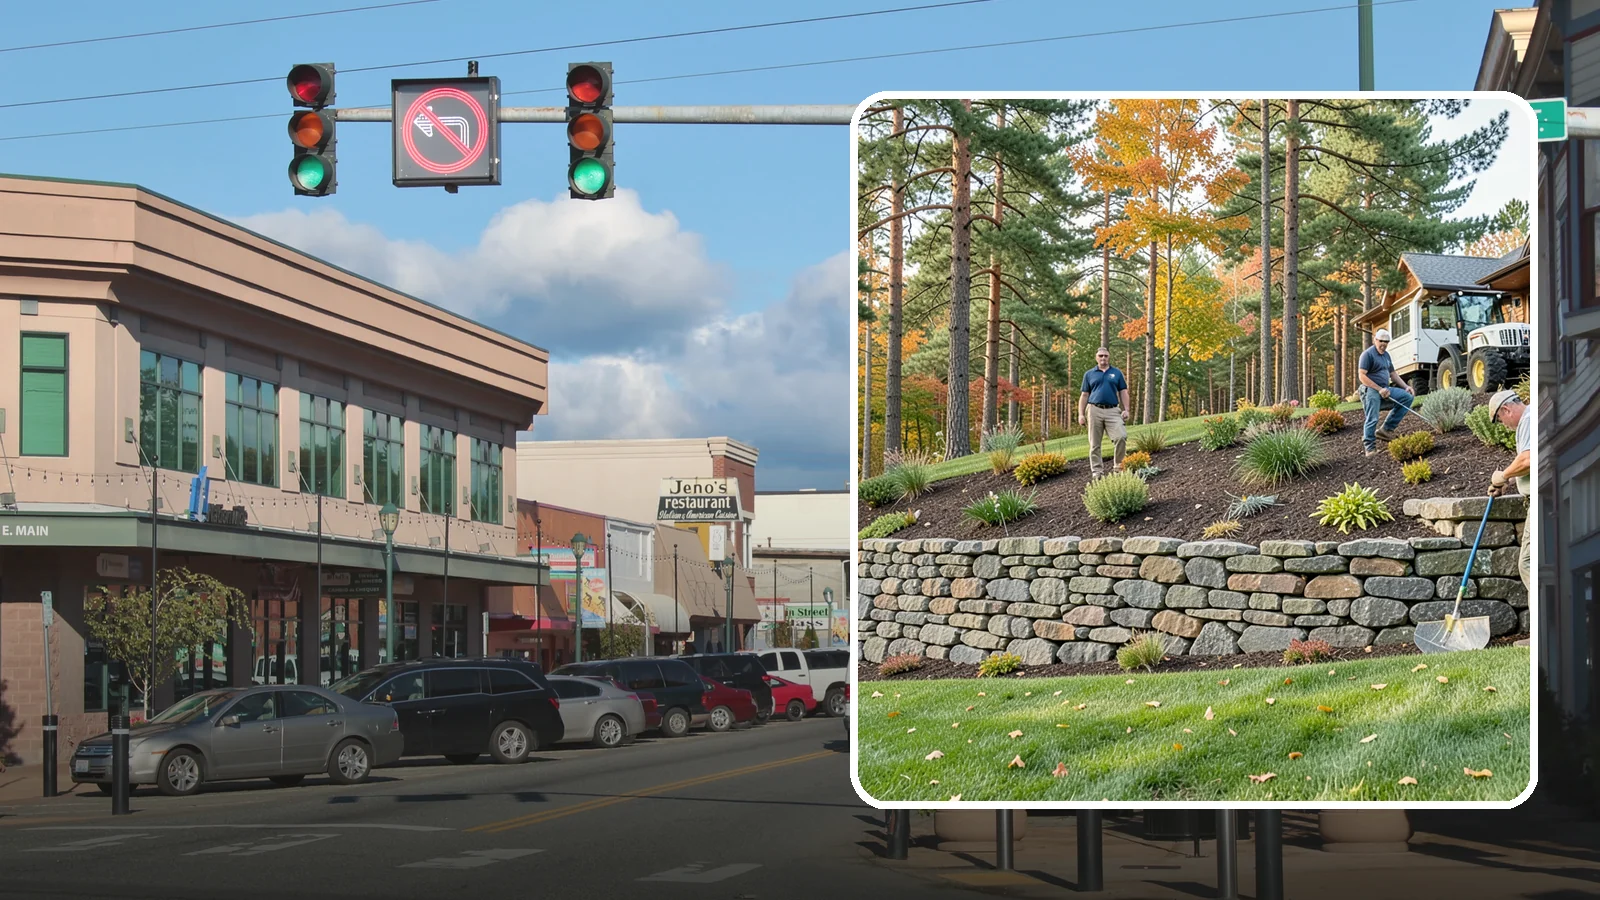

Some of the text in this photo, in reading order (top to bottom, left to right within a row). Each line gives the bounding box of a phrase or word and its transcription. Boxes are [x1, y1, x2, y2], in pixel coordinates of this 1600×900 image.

[669, 480, 727, 494] Jeno's
[665, 496, 731, 509] restaurant
[658, 510, 682, 519] Italian
[685, 509, 714, 519] American
[714, 509, 737, 519] Cuisine
[2, 525, 49, 536] E. MAIN
[797, 607, 828, 617] Street
